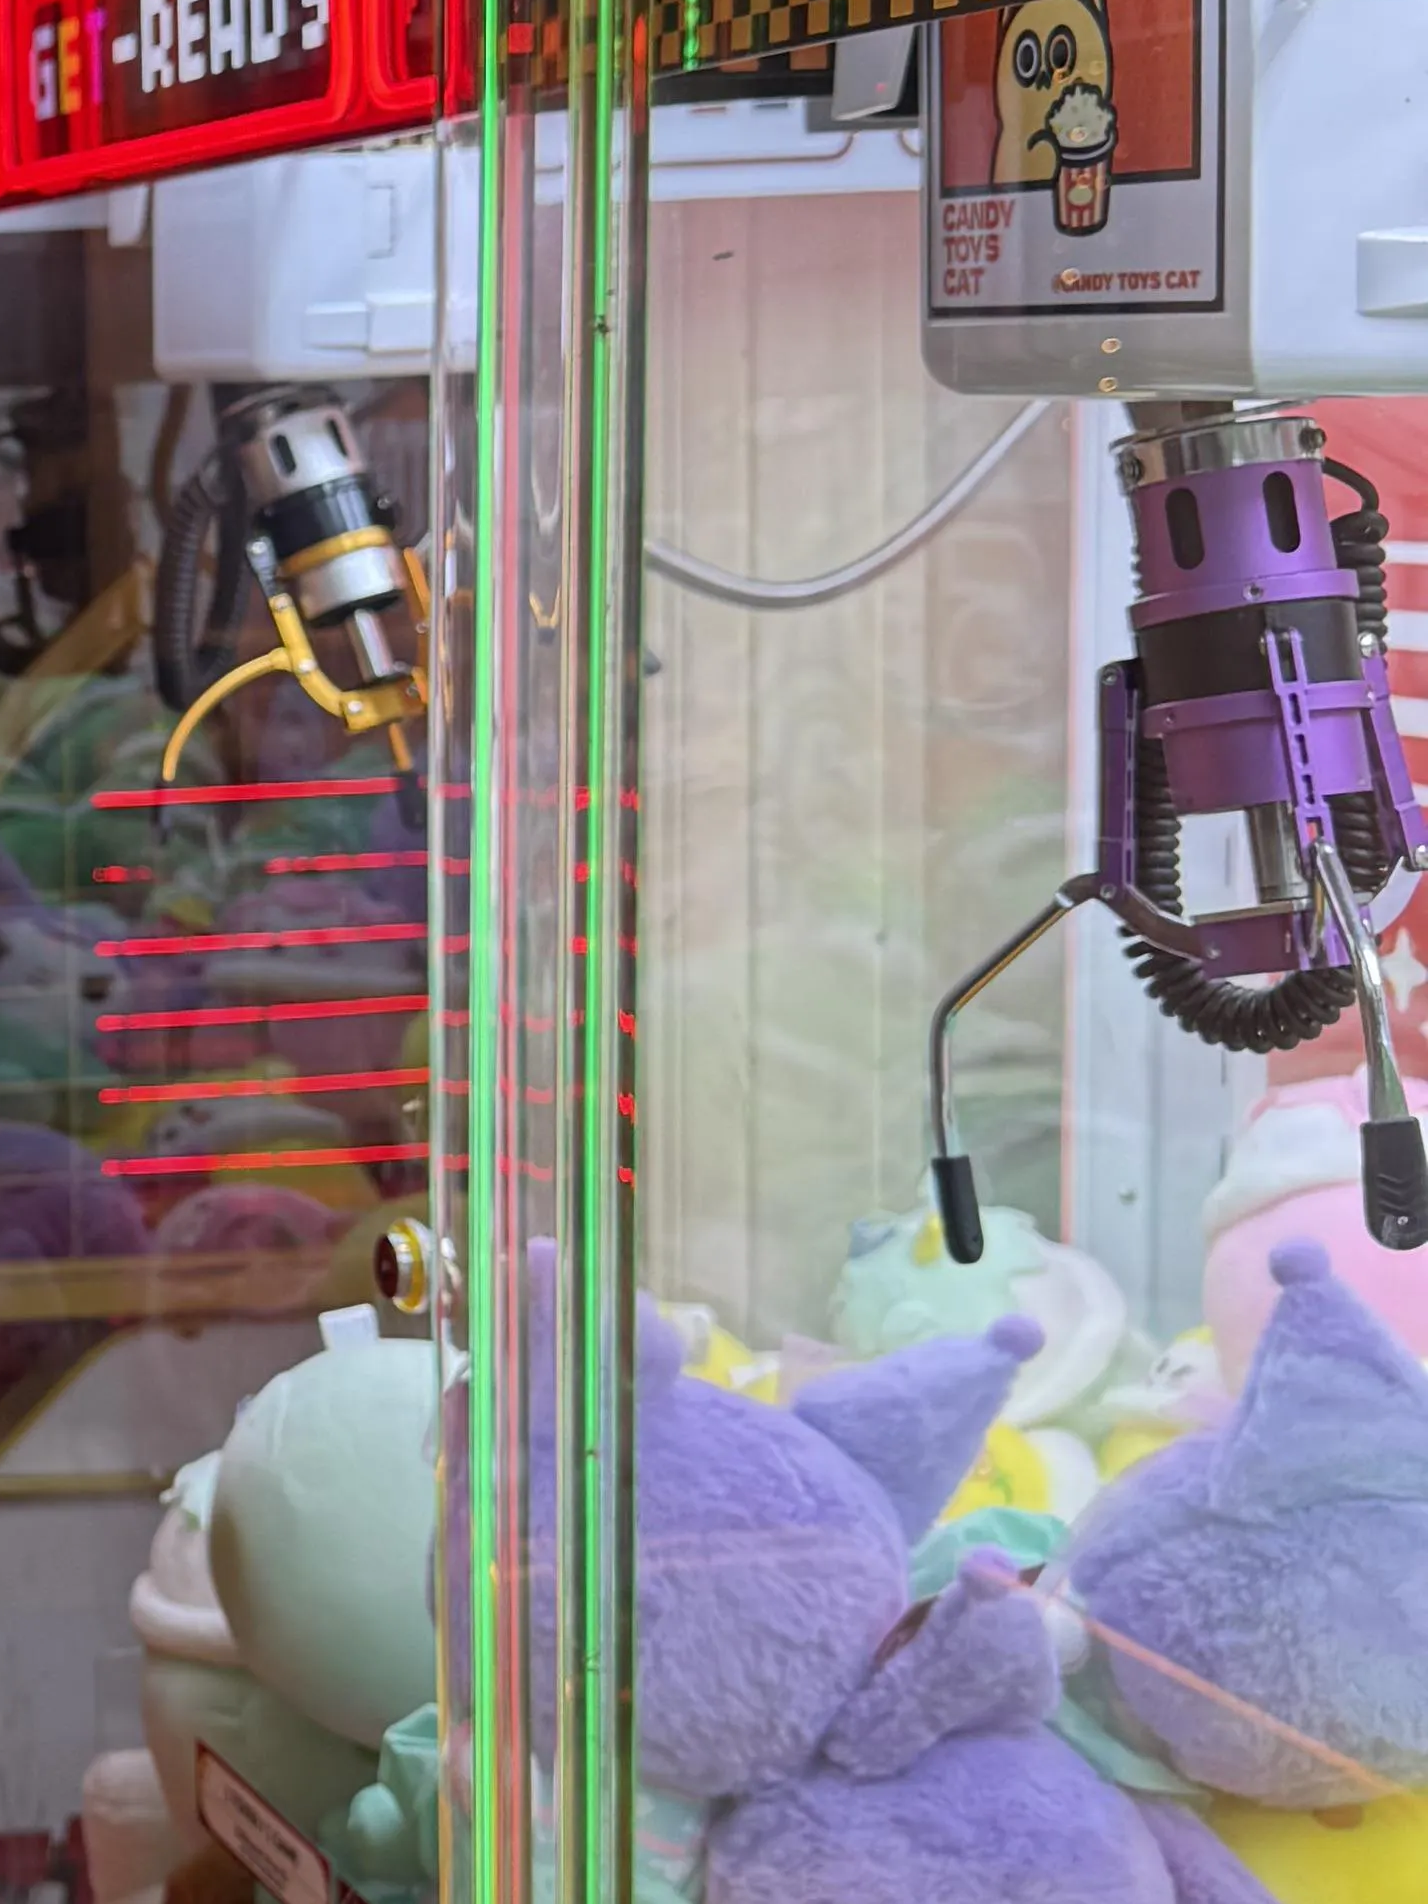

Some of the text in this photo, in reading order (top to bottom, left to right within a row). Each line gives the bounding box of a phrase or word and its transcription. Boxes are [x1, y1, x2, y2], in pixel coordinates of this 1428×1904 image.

[942, 198, 1016, 232] CANDY
[942, 234, 1000, 264] TOYS
[943, 268, 985, 296] CAT
[1117, 271, 1161, 291] TOYS
[1164, 269, 1202, 290] CAT
